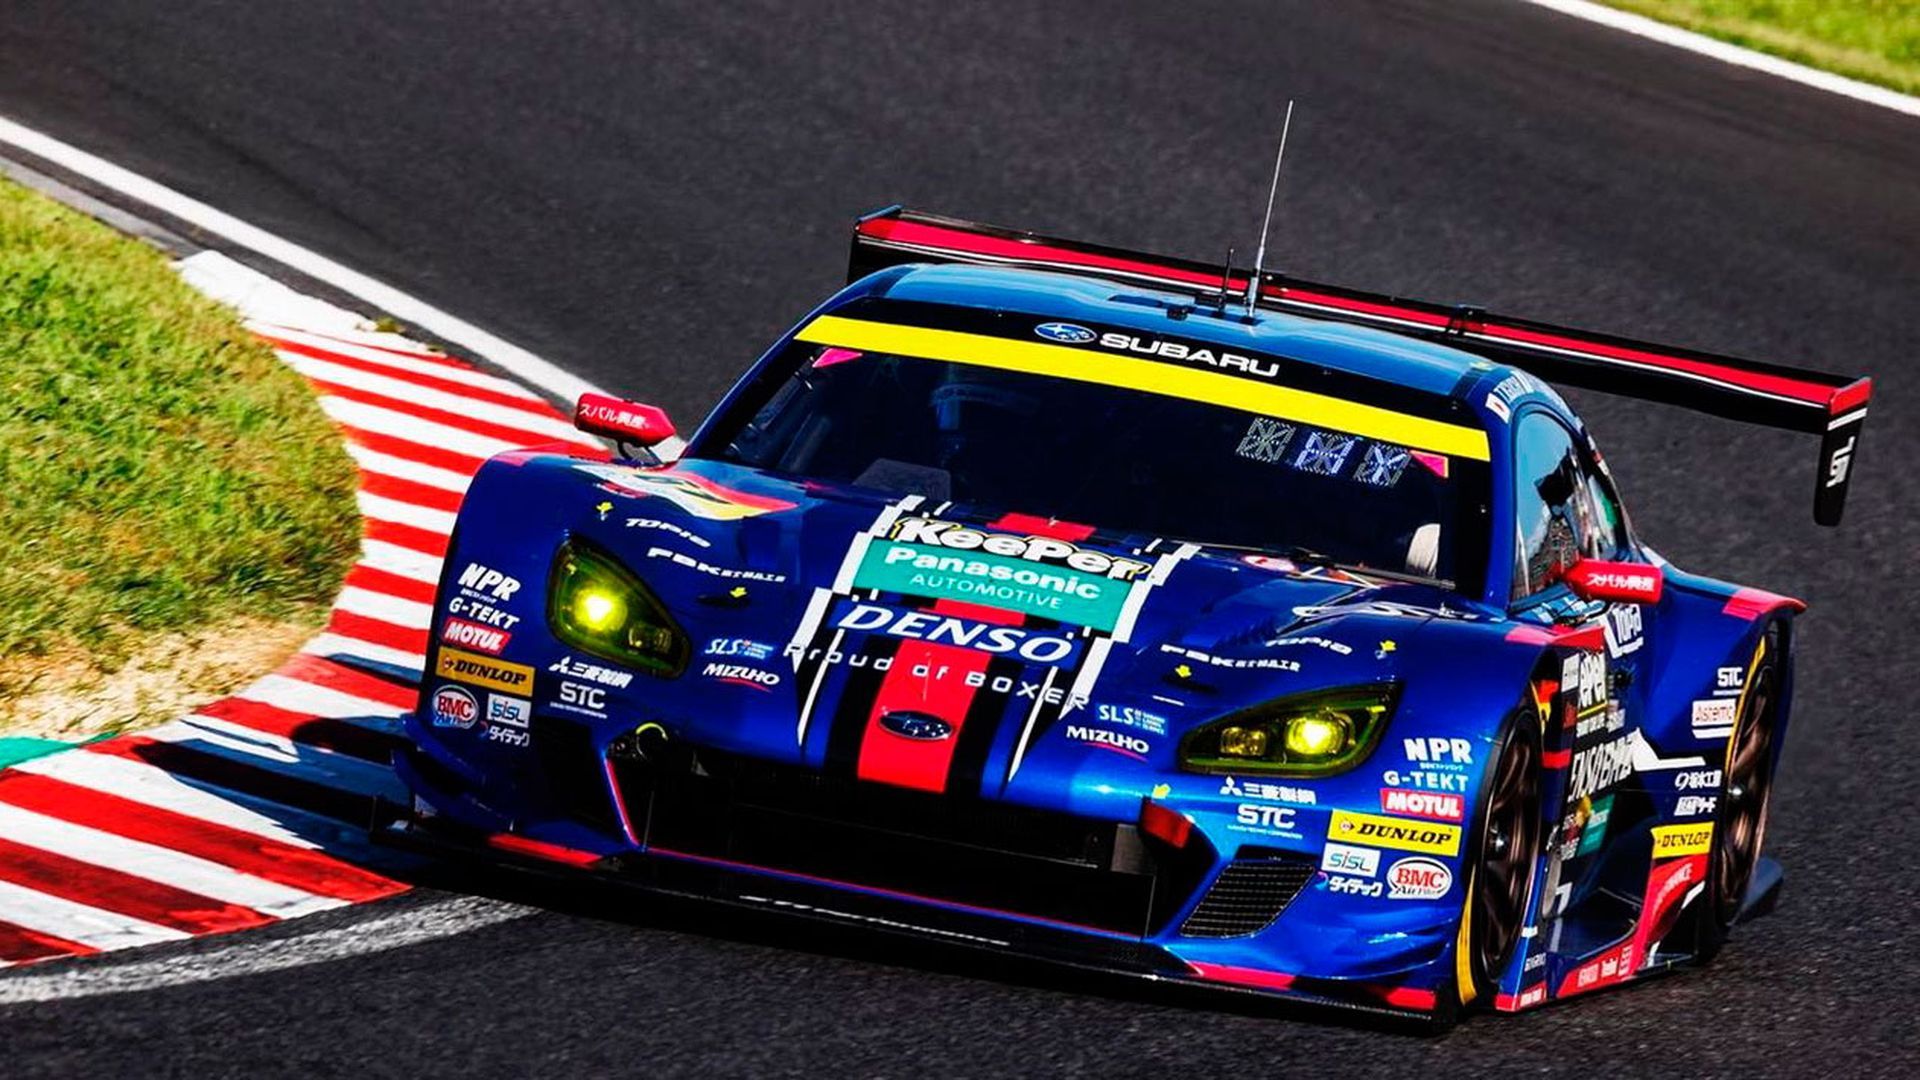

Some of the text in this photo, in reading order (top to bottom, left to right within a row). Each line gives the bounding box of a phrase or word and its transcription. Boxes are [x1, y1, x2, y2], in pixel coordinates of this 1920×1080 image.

[1100, 333, 1279, 377] SUBARU
[457, 562, 521, 602] NPR
[884, 546, 1101, 599] Panasonic
[909, 573, 1062, 610] AUTOMOTIVE
[448, 596, 520, 630] G-TEKT
[444, 620, 504, 651] MOTUL
[704, 638, 743, 655] SLS
[838, 604, 1073, 663] DENSO
[455, 659, 527, 685] DUNLOP
[702, 663, 781, 685] MIZUHO
[782, 642, 895, 672] Proud
[911, 664, 949, 681] of
[964, 671, 1090, 711] BOXER
[1717, 667, 1743, 687] STC
[437, 695, 473, 719] BMC
[560, 680, 606, 709] STC
[1099, 704, 1134, 725] SLS
[1066, 725, 1149, 754] MIZUHO
[1403, 737, 1474, 765] NPR
[1383, 770, 1469, 792] G-TEKT
[1236, 803, 1296, 830] STC
[1386, 791, 1460, 818] MOTUL
[1357, 822, 1451, 846] DUNLOP
[1661, 831, 1711, 848] DUNLOP
[1395, 868, 1444, 889] BMC
